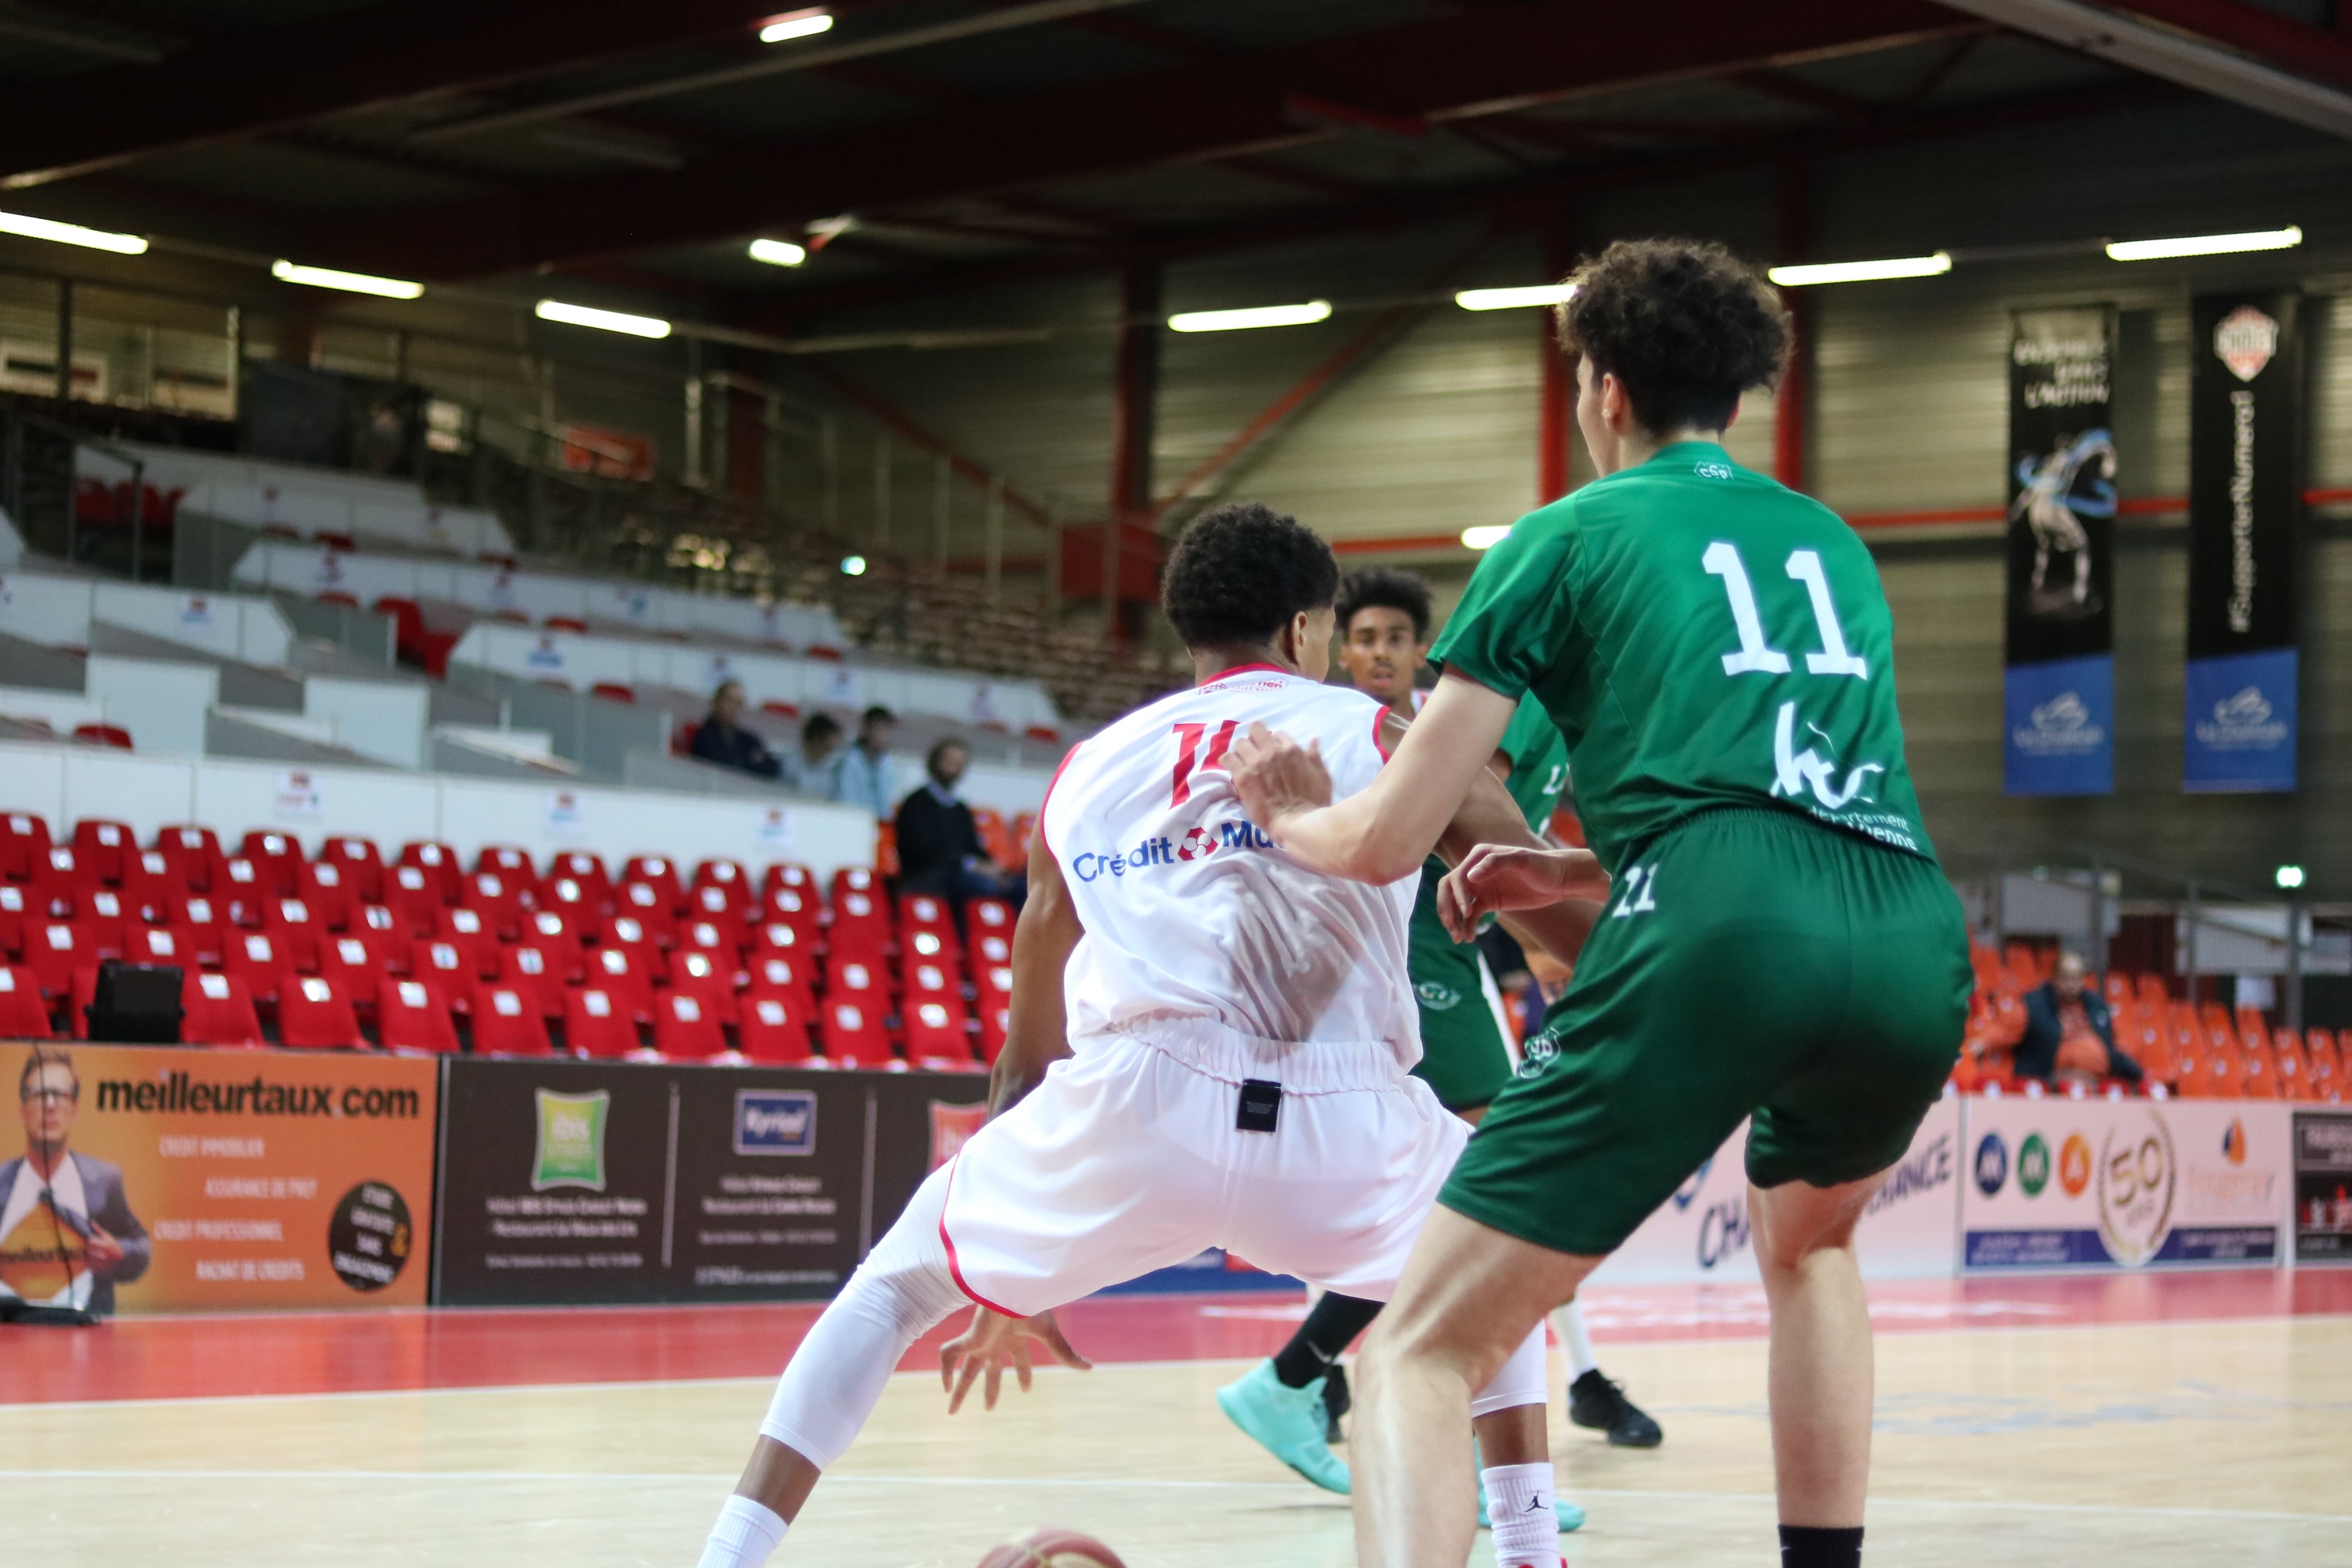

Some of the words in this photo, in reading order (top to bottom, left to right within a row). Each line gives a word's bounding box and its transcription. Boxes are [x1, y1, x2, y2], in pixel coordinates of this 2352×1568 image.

[1702, 541, 1868, 680] 11
[1073, 836, 1174, 883] Crédit
[1223, 820, 1286, 850] Mu
[97, 1070, 420, 1119] meilleurtaux.com
